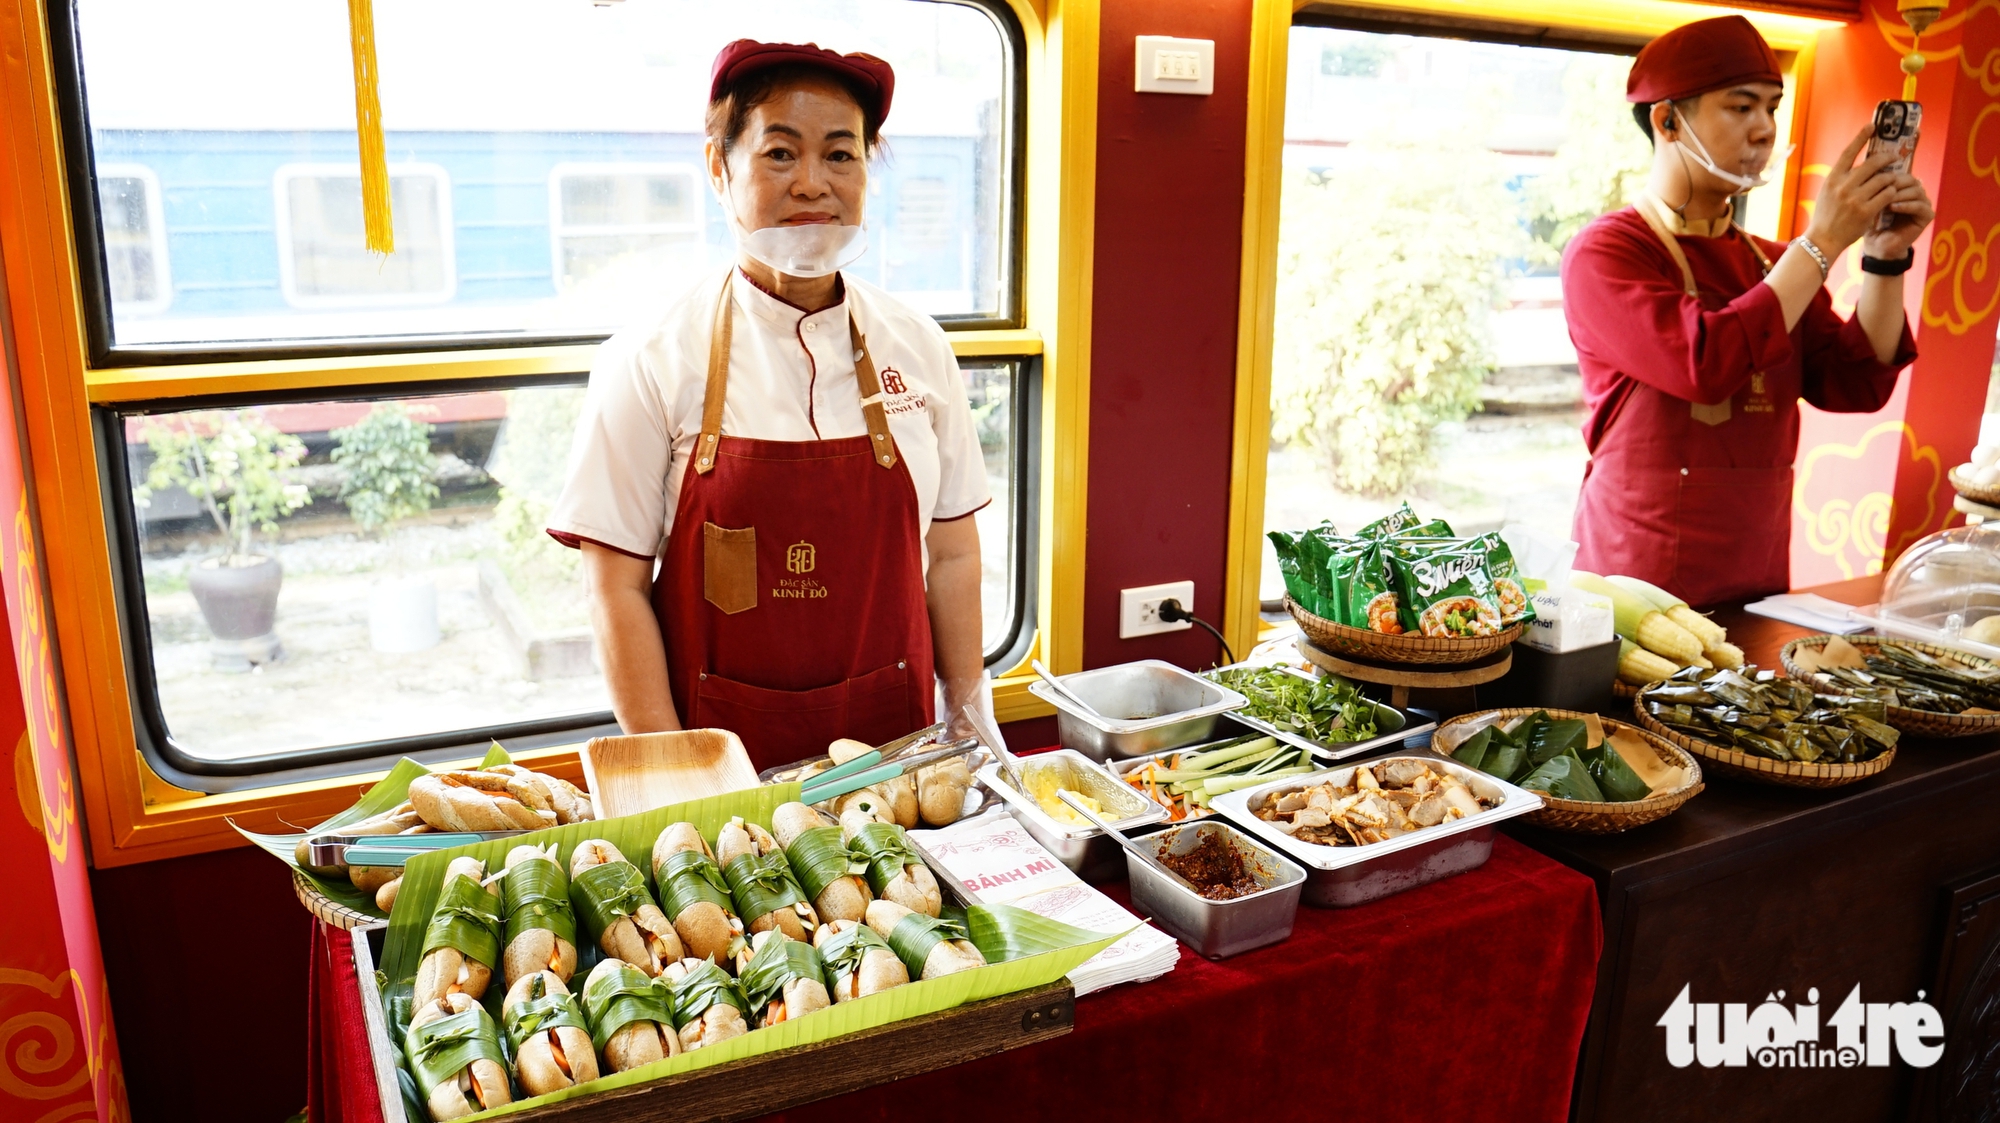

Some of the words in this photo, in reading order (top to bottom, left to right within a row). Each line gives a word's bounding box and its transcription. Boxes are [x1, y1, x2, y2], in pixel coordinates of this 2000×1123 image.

[772, 588, 805, 599] KINH
[809, 586, 828, 599] ĐÔ
[963, 873, 1027, 892] BÁNH
[1025, 856, 1057, 875] MÌ
